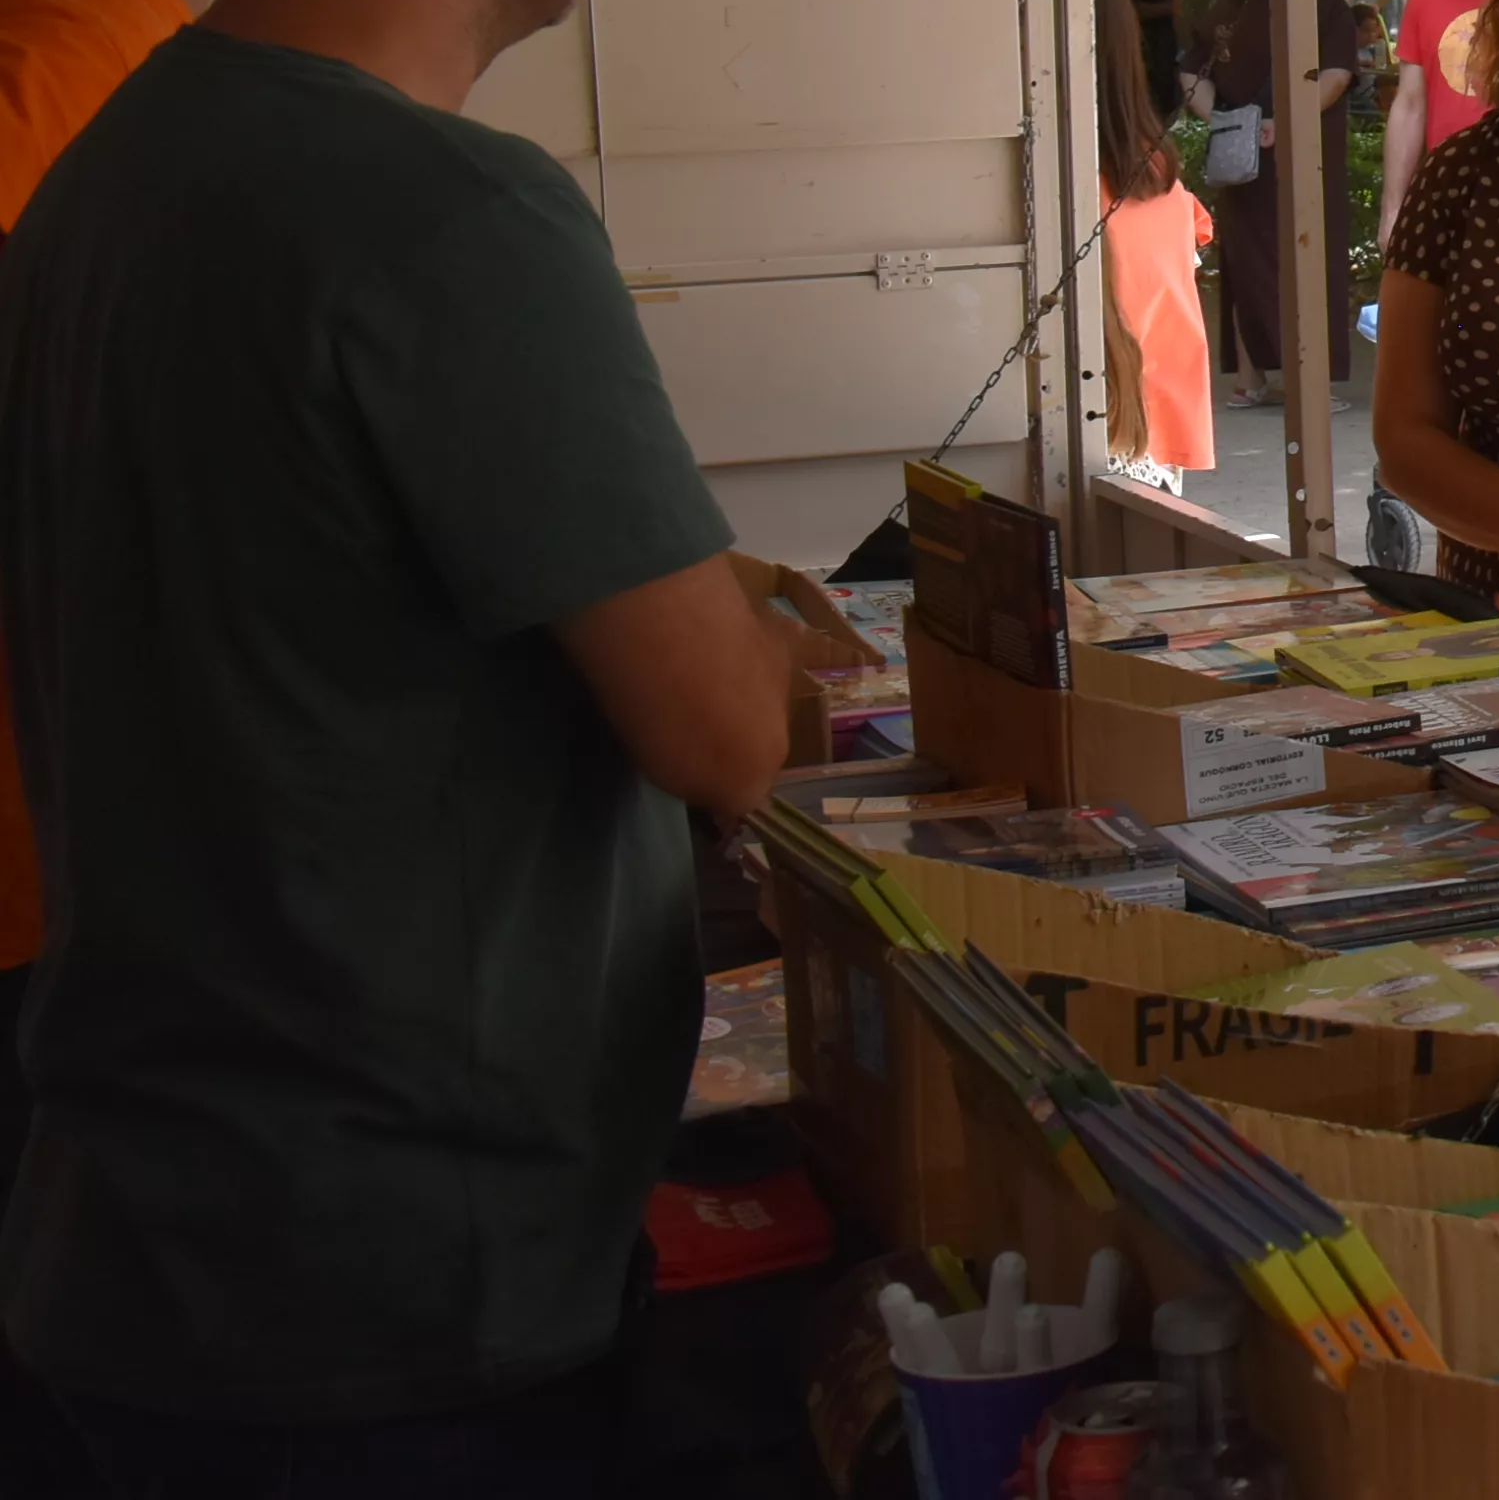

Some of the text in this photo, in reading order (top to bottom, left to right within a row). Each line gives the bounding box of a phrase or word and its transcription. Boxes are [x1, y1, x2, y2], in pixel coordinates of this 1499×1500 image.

[1205, 728, 1224, 744] 52
[1255, 750, 1304, 766] EDITORIAL
[1268, 772, 1287, 781] DEL
